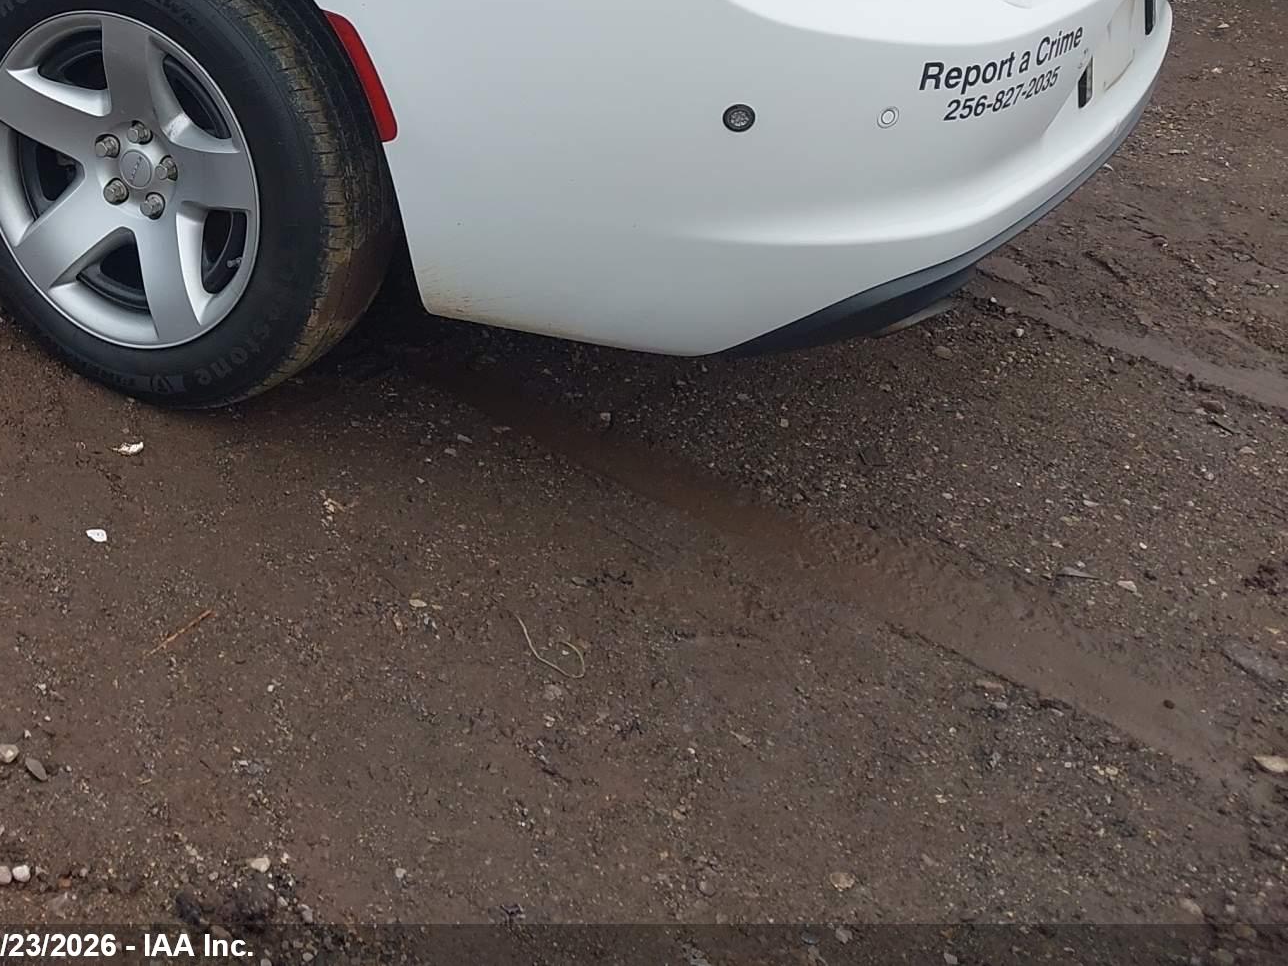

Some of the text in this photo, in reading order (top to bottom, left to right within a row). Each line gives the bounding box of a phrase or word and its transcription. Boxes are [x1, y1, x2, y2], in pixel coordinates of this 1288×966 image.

[918, 26, 1084, 95] Report a Crime
[943, 65, 1062, 122] 256-827-2035
